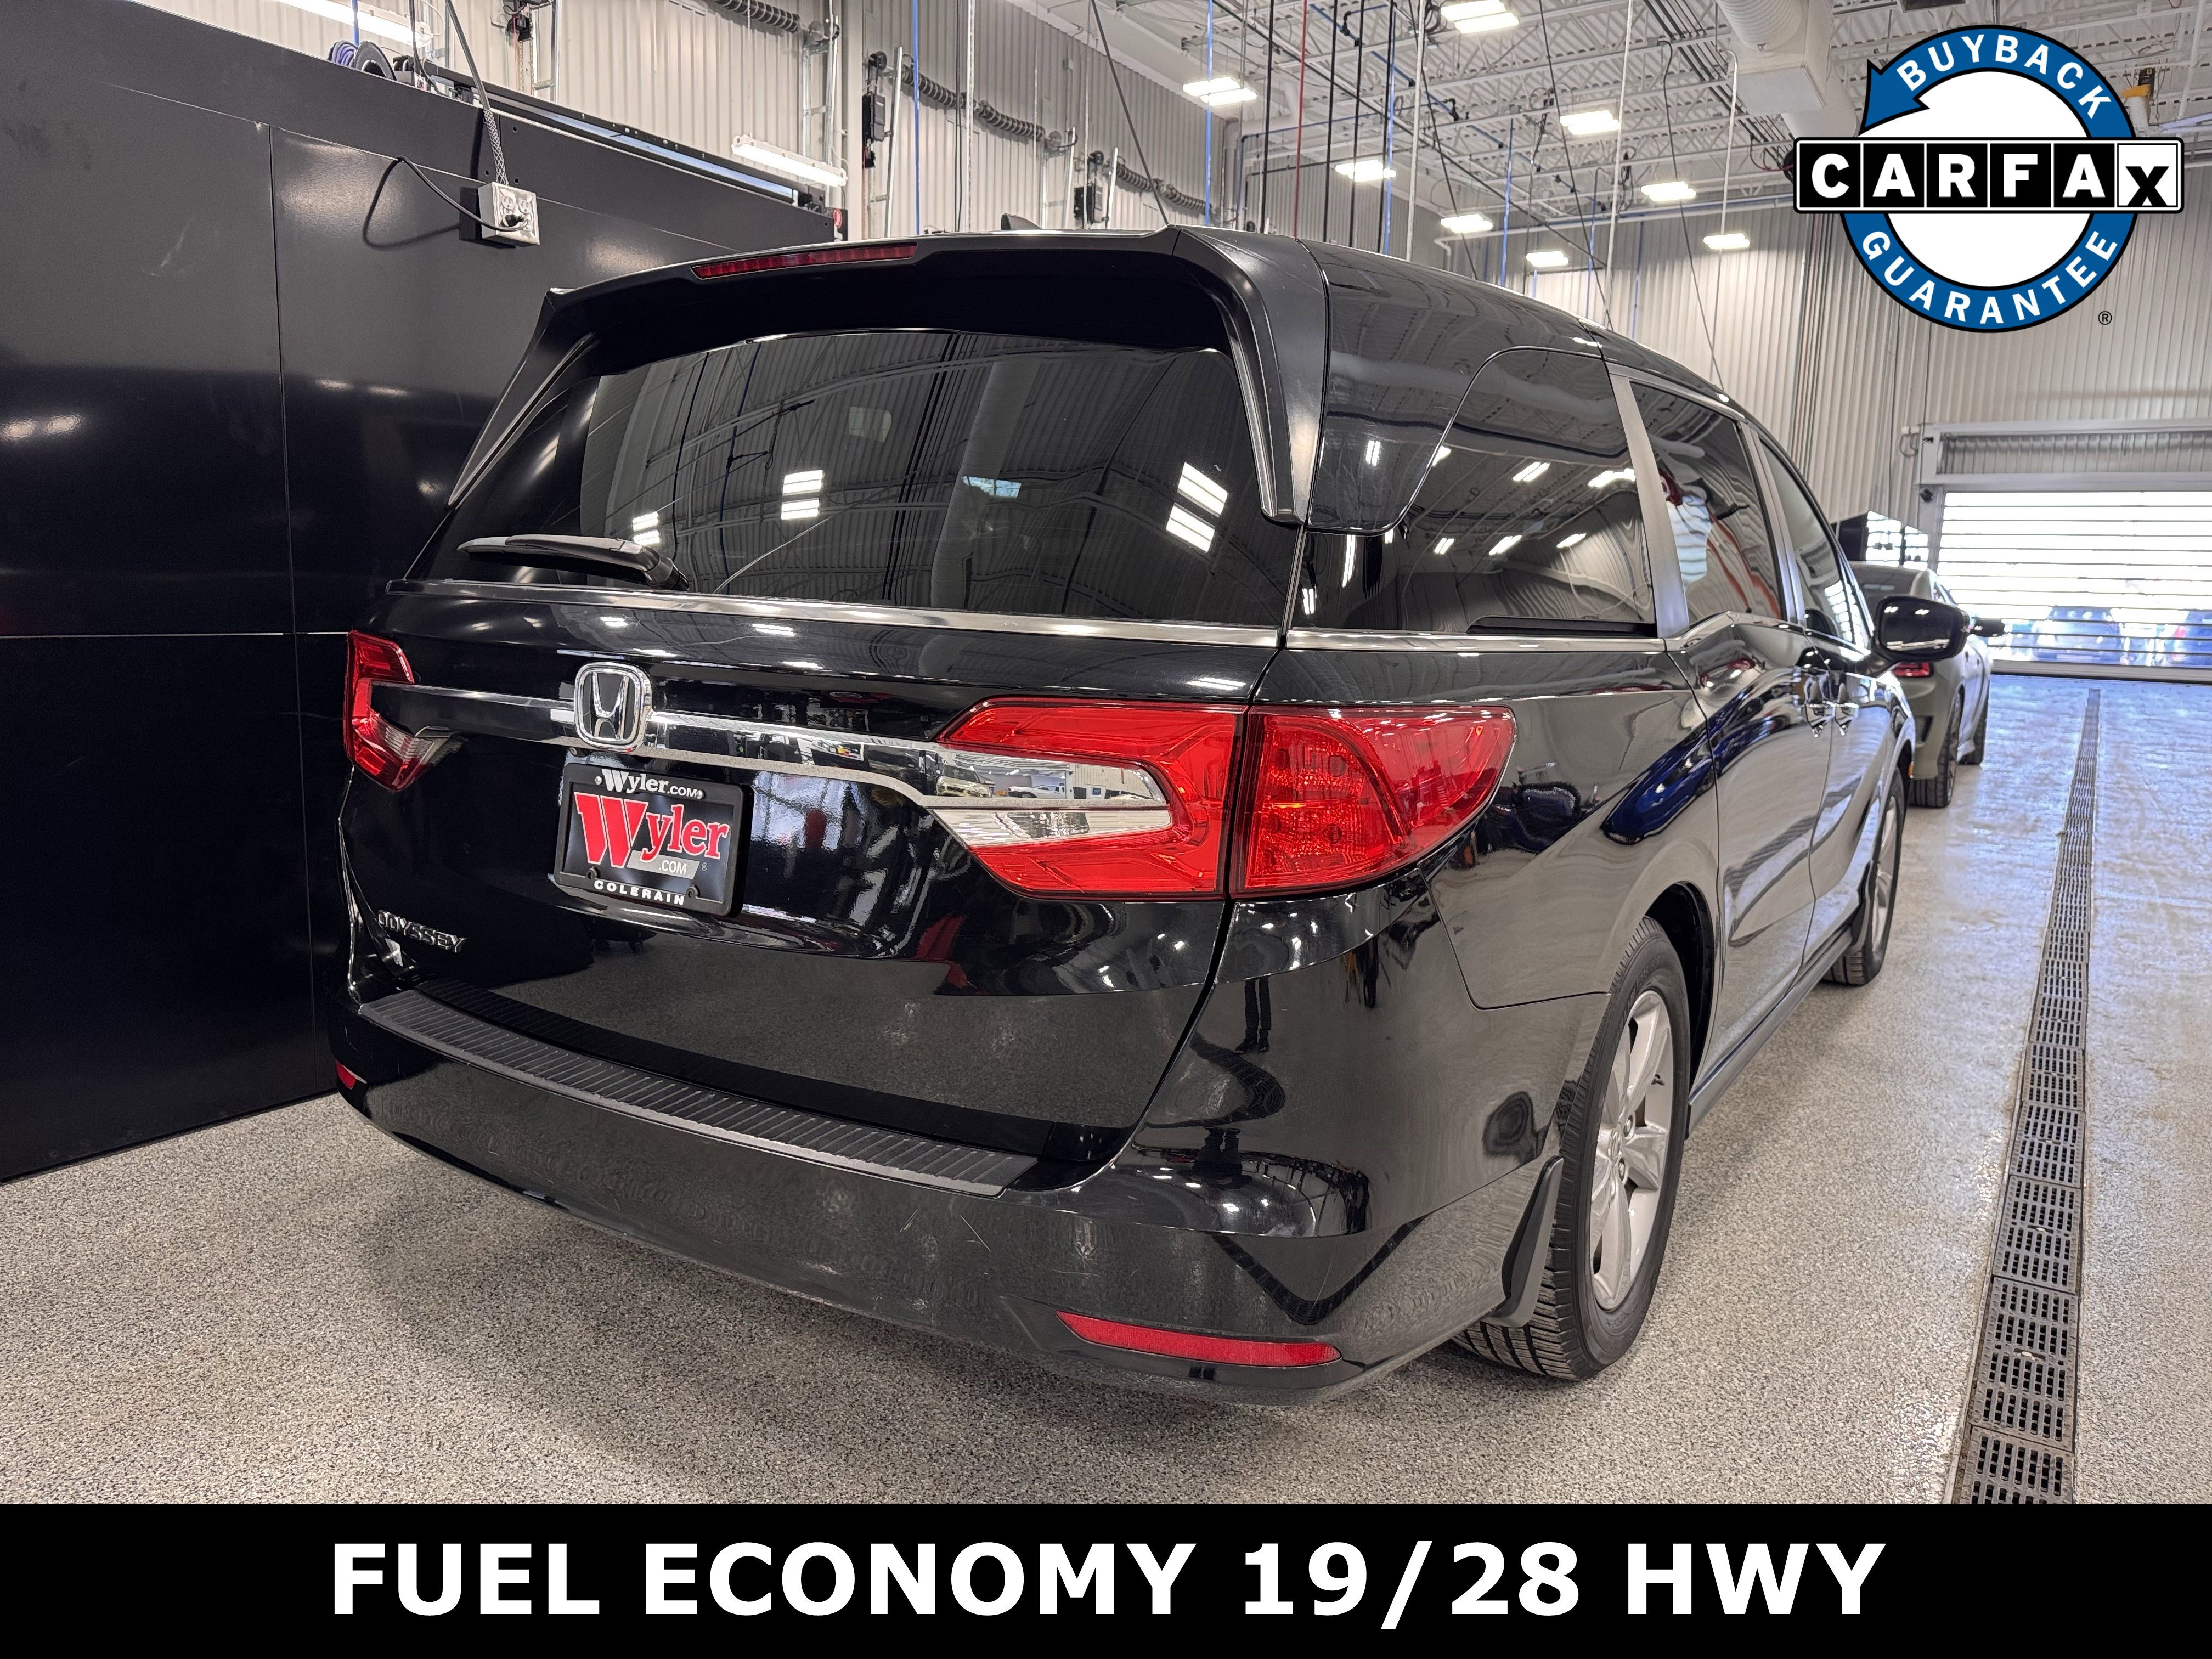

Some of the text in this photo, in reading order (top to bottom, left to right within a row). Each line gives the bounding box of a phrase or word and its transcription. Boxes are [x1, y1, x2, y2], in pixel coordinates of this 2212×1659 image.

[573, 791, 730, 869] Wyler
[594, 879, 685, 906] COLERAIN
[377, 910, 468, 953] ODYSSEY
